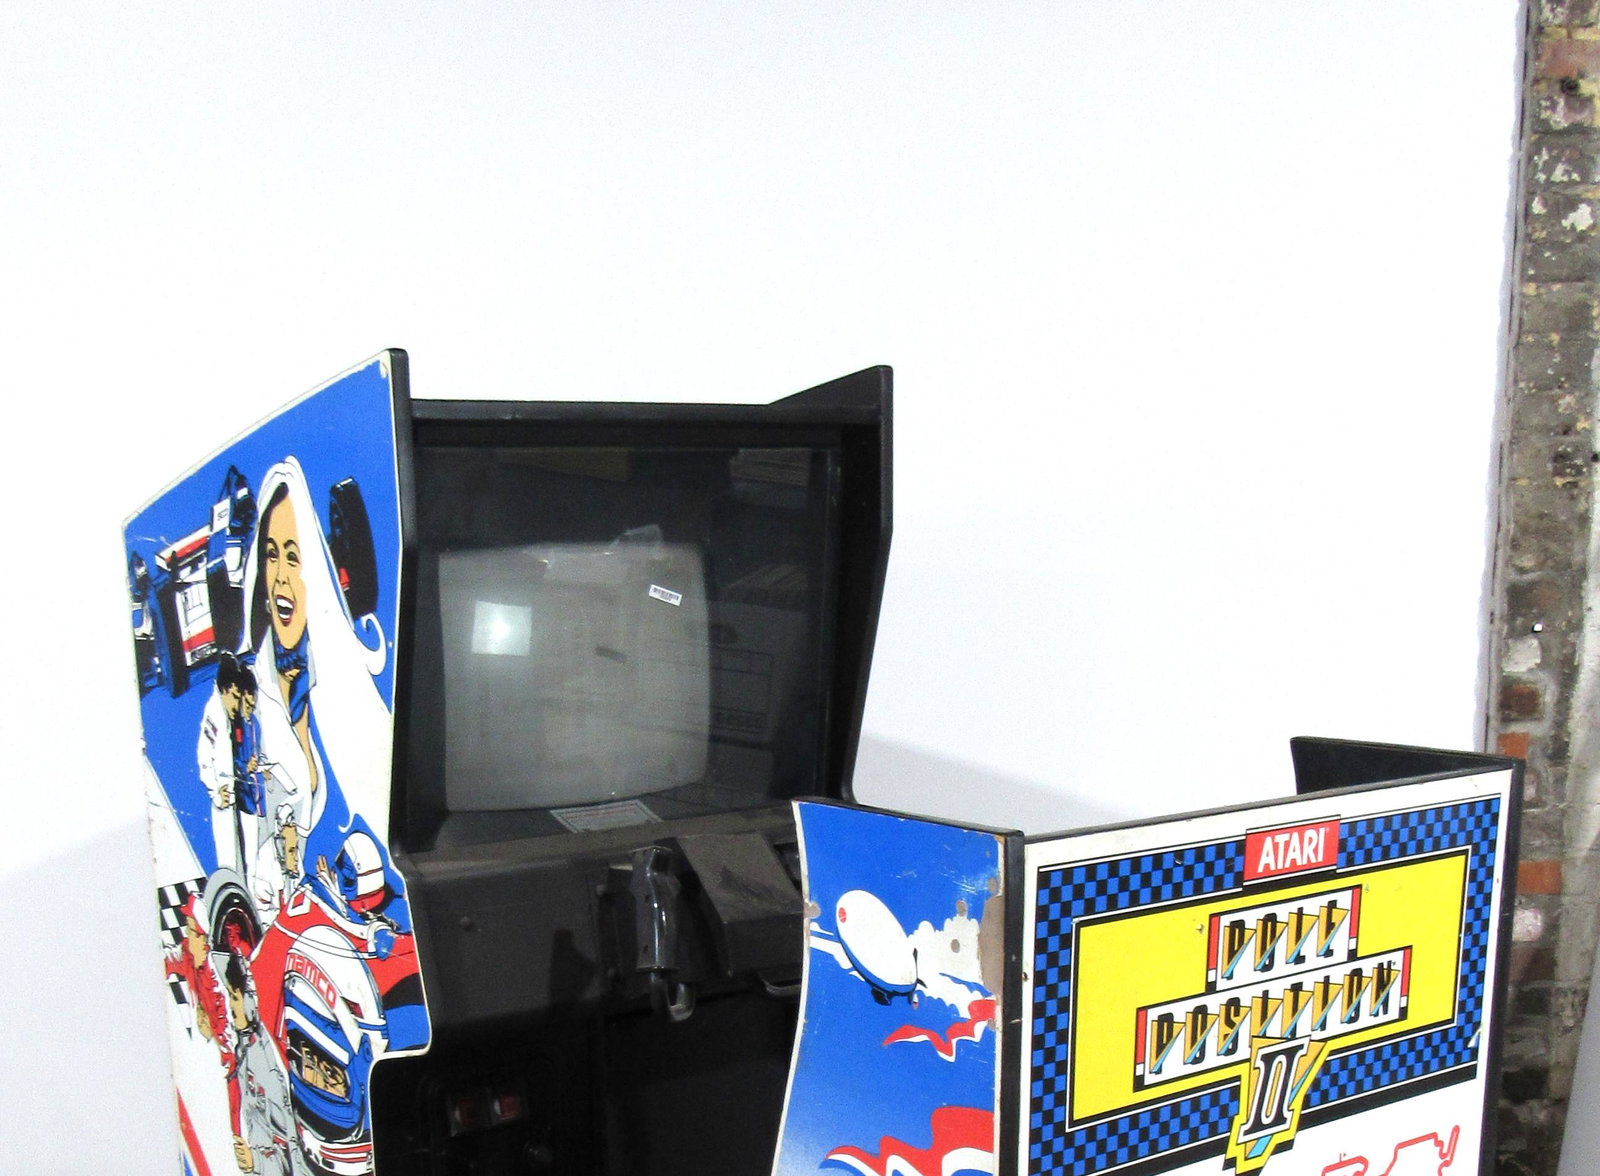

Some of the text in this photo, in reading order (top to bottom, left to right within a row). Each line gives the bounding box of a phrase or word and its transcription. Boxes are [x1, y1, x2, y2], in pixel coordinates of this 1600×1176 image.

[1257, 827, 1325, 873] ATARI
[1222, 899, 1349, 981] POLE
[1149, 960, 1400, 1075] POSITION
